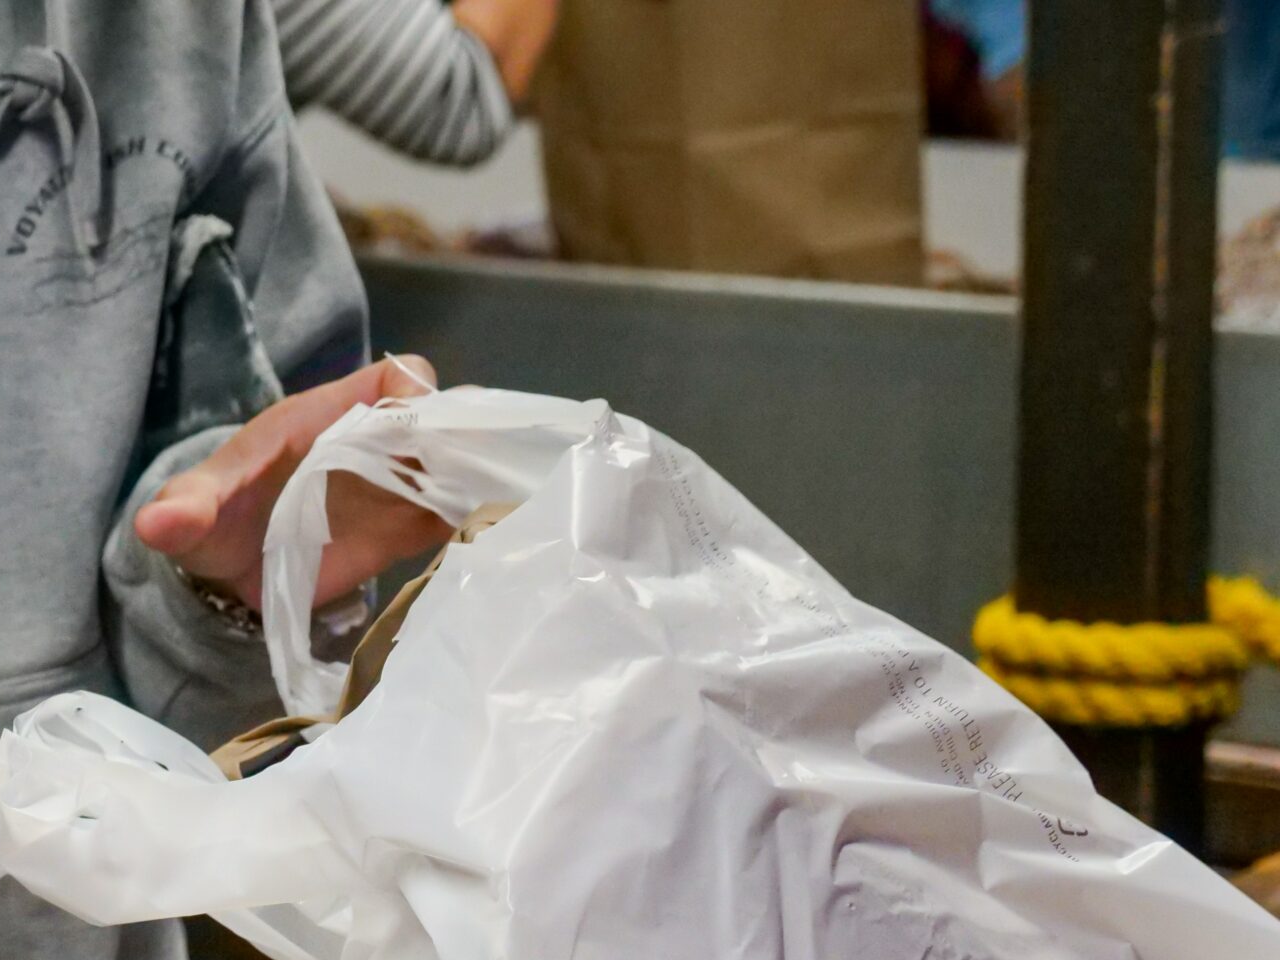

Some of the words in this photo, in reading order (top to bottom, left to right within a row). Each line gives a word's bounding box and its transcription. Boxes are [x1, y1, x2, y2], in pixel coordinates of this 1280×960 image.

[914, 676, 932, 695] TO
[933, 696, 983, 751] RETURN
[974, 751, 1023, 802] PLEASE
